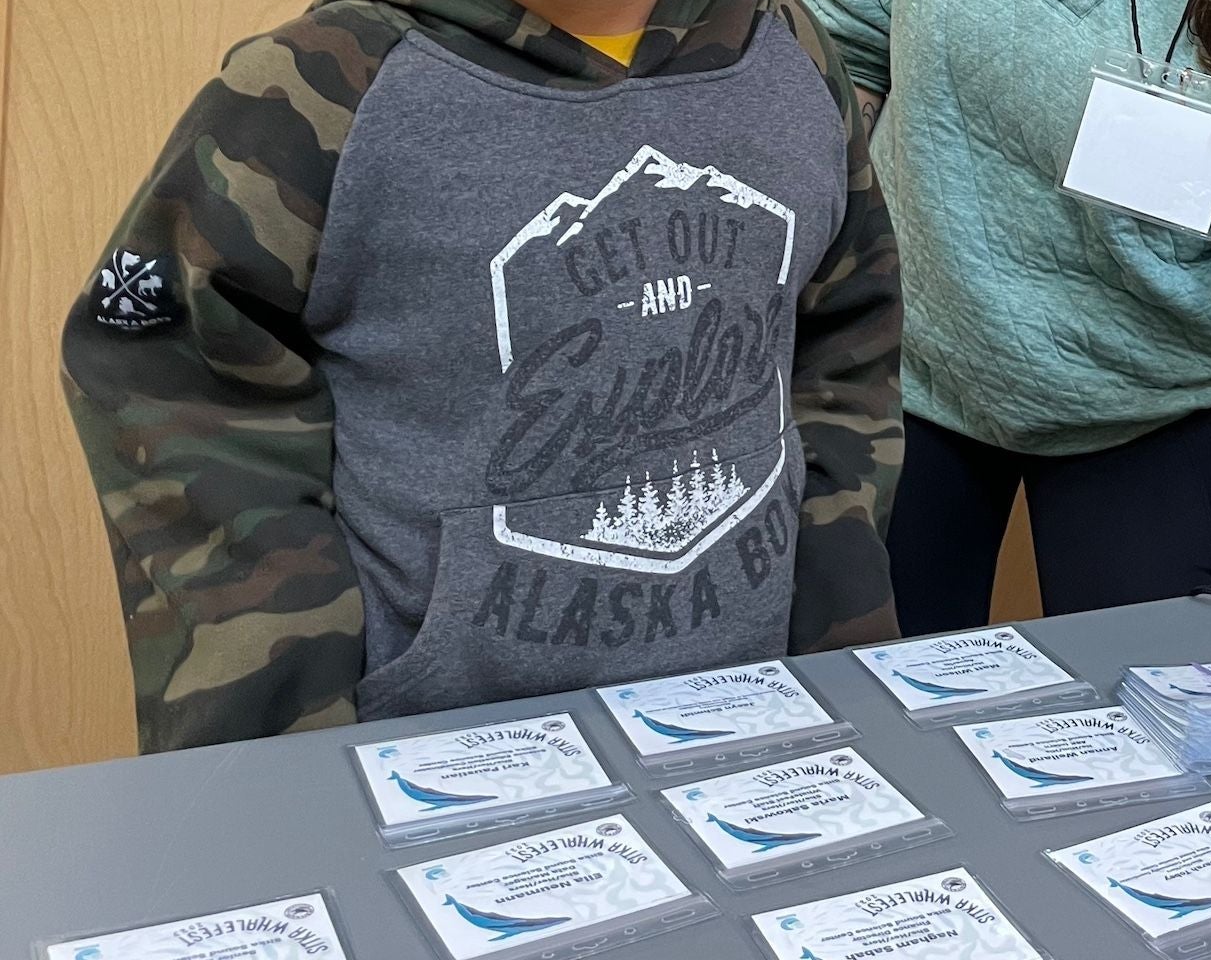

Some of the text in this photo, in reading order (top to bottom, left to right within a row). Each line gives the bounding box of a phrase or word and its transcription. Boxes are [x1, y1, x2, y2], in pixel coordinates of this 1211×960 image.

[564, 209, 745, 296] GET OUT
[473, 561, 723, 646] ALASKA
[938, 638, 1037, 660] SITKA WHALEFEST
[690, 674, 800, 699] SITKA WHALEFEST
[459, 728, 581, 758] SITKA WHALEFEST
[1043, 718, 1150, 745] SITKA WHALEFEST
[760, 764, 880, 790] SITKA WHALEFEST
[744, 794, 850, 824] Maria Sakowski
[512, 835, 648, 864] SITKA WHALEFEST
[495, 872, 603, 904] Ella Neumann
[860, 888, 996, 924] SITKA WHALEFEST
[178, 916, 328, 955] SITKA WHALEFEST
[896, 929, 958, 949] Nagham
